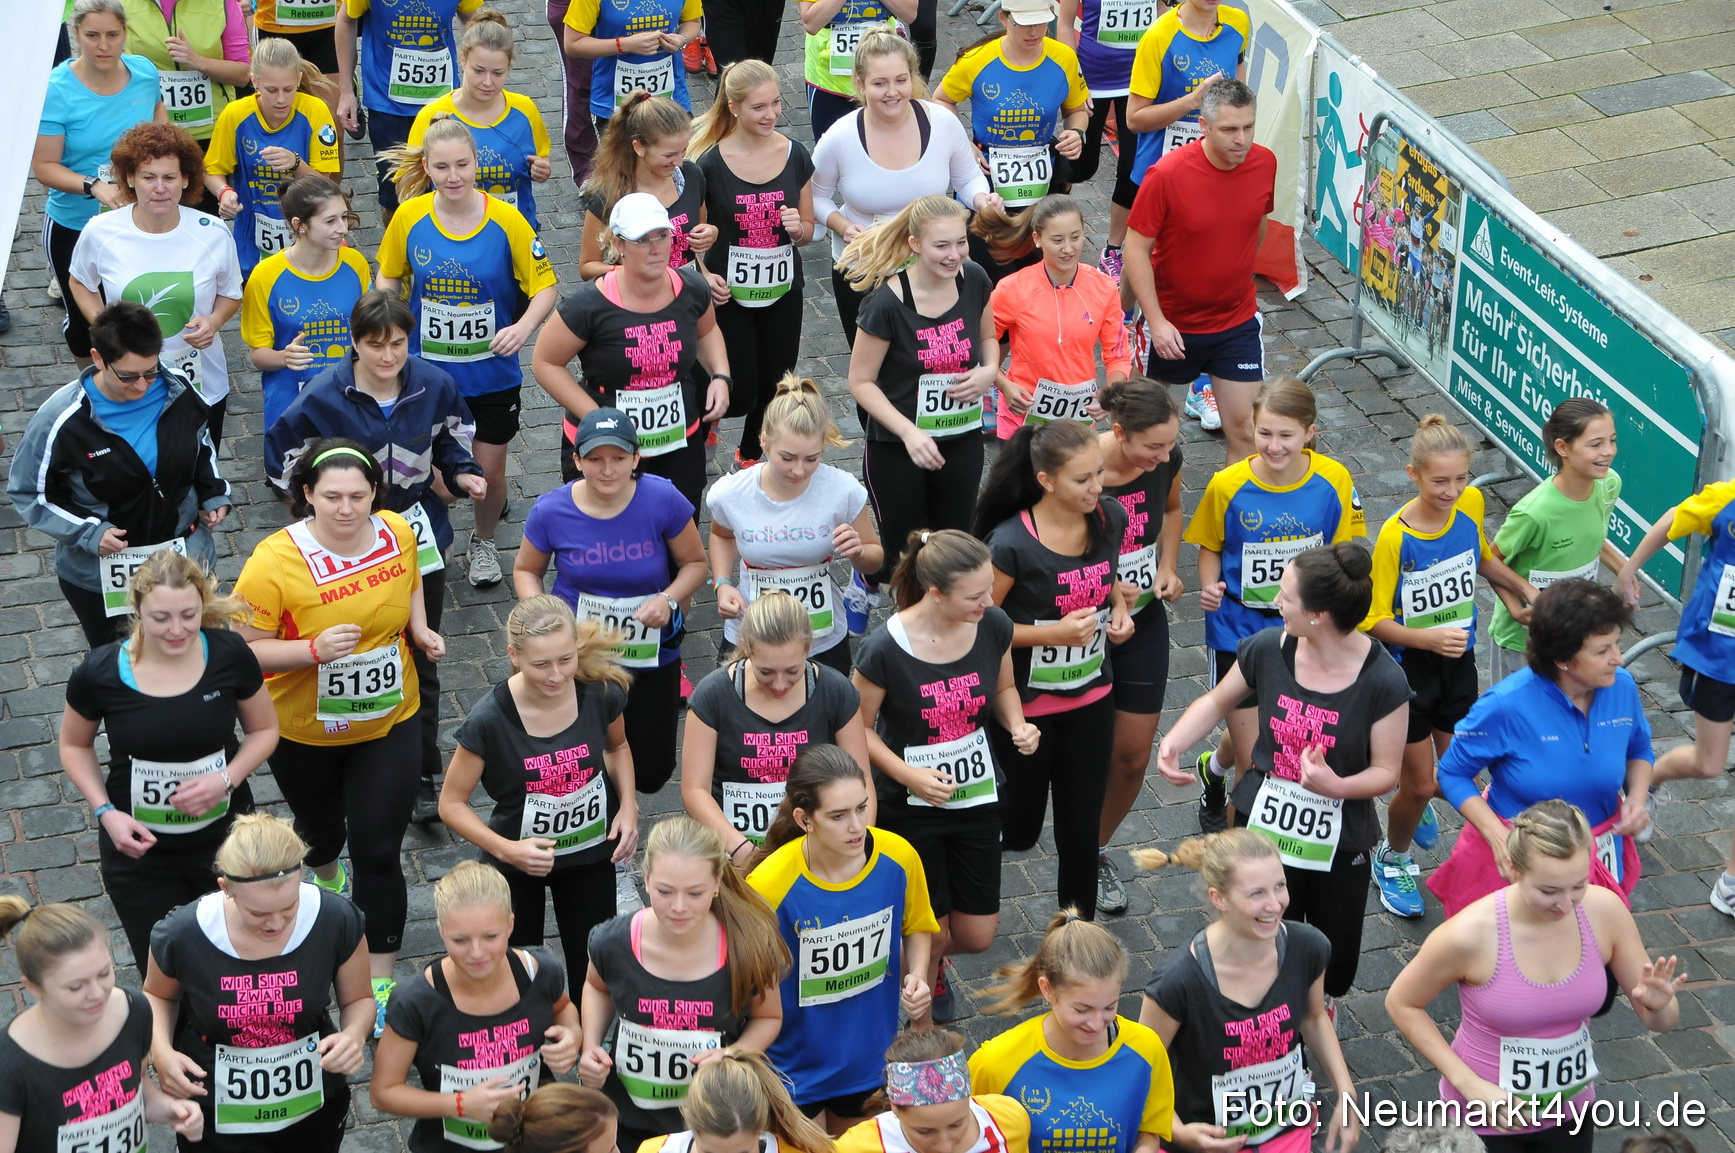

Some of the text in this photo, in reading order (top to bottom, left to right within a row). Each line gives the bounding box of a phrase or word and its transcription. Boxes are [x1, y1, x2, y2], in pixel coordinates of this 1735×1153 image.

[291, 6, 324, 18] Rebecca
[1106, 7, 1152, 28] 5113
[1118, 33, 1138, 41] Heidi
[395, 53, 446, 64] PARTL Neumarkt
[398, 62, 448, 84] 5531
[617, 65, 666, 75] PARTL Neumarkt
[621, 71, 669, 95] 5537
[174, 110, 187, 121] Evi
[1168, 125, 1190, 134] PARTL
[991, 152, 1042, 161] PARTL Neumarkt
[997, 159, 1048, 185] 5210
[736, 191, 784, 204] WIR SIND
[1017, 188, 1032, 198] Bea
[735, 211, 764, 221] NICHT
[746, 202, 775, 212] ZWAR
[257, 219, 276, 230] PARTL
[730, 251, 753, 260] PARTL
[734, 260, 788, 285] 5110
[749, 290, 772, 299] Frizzi
[1500, 246, 1608, 349] Event-Leit-Systeme
[423, 305, 482, 319] PARTL Neumarkt
[1465, 280, 1513, 341] Mehr
[428, 317, 491, 341] 5145
[447, 345, 469, 355] Nina
[1461, 320, 1557, 423] für Ihr Eve
[920, 379, 943, 387] PARTL
[1038, 383, 1091, 397] PARTL Neumarkt
[618, 391, 676, 405] PARTL Neumarkt
[1037, 394, 1093, 418] 5013
[625, 401, 680, 431] 5028
[935, 416, 968, 429] Kristina
[1457, 375, 1559, 476] Miet & Service Line
[639, 434, 670, 448] Verena
[741, 525, 816, 543] adidas
[1609, 513, 1632, 546] 352
[101, 552, 131, 560] PARTL
[569, 540, 655, 565] adidas
[1275, 544, 1313, 556] Neumarkt
[320, 562, 407, 605] MAX BÖGL
[779, 573, 817, 585] Neumarkt
[1403, 562, 1465, 587] PARTL Neumarkt
[1412, 571, 1474, 613] 5036
[580, 598, 608, 611] PARTL
[1434, 610, 1458, 623] Nina
[321, 653, 389, 671] PARTL Neumarkt
[328, 662, 397, 697] 5139
[920, 672, 980, 697] WIR SIND
[1062, 669, 1082, 681] Lisa
[351, 701, 375, 713] Elke
[1277, 694, 1339, 725] WIR SIND
[1285, 710, 1324, 734] ZWAR
[743, 730, 808, 746] WIR SIND
[1270, 716, 1336, 748] NICHT DIE
[524, 744, 590, 771] WIR SIND
[756, 745, 797, 758] ZWAR
[907, 741, 975, 763] PARTL Neumarkt
[135, 766, 213, 777] PARTL Neumarkt
[540, 760, 580, 780] ZWAR
[741, 757, 782, 769] NICHT
[921, 750, 987, 784] 008
[142, 780, 181, 805] 52
[526, 774, 567, 792] NICHT
[527, 798, 558, 810] PARTL
[560, 787, 594, 809] Neumarkt
[725, 790, 754, 799] PARTL
[1263, 780, 1331, 807] PARTL Neumarkt
[532, 795, 600, 836] 5056
[1260, 795, 1334, 842] 5095
[554, 835, 578, 848] Anja
[802, 920, 880, 945] PARTL Neumarkt
[811, 928, 885, 976] 5017
[221, 971, 298, 990] WIR SIND
[826, 970, 870, 993] Merima
[237, 987, 284, 1004] ZWAR
[218, 999, 303, 1019] NICHT DIE
[638, 998, 714, 1018] WIR SIND
[653, 1013, 699, 1027] ZWAR
[1225, 1003, 1291, 1037] WIR SIND
[458, 1018, 530, 1049] WIR SIND
[621, 1026, 702, 1051] PARTL Neumarkt
[218, 1047, 302, 1065] PARTL Neumarkt
[474, 1037, 519, 1060] ZWAR
[1503, 1038, 1584, 1057] PARTL Neumarkt
[227, 1058, 314, 1100] 5030
[1214, 1065, 1293, 1090] PARTL Neumarkt
[1511, 1048, 1588, 1091] 5169
[62, 1059, 133, 1108] WIR SIND
[443, 1073, 475, 1086] PARTL
[653, 1086, 680, 1098] Lilli
[60, 1102, 143, 1142] PARTL Neumarkt
[255, 1107, 288, 1120] Jana
